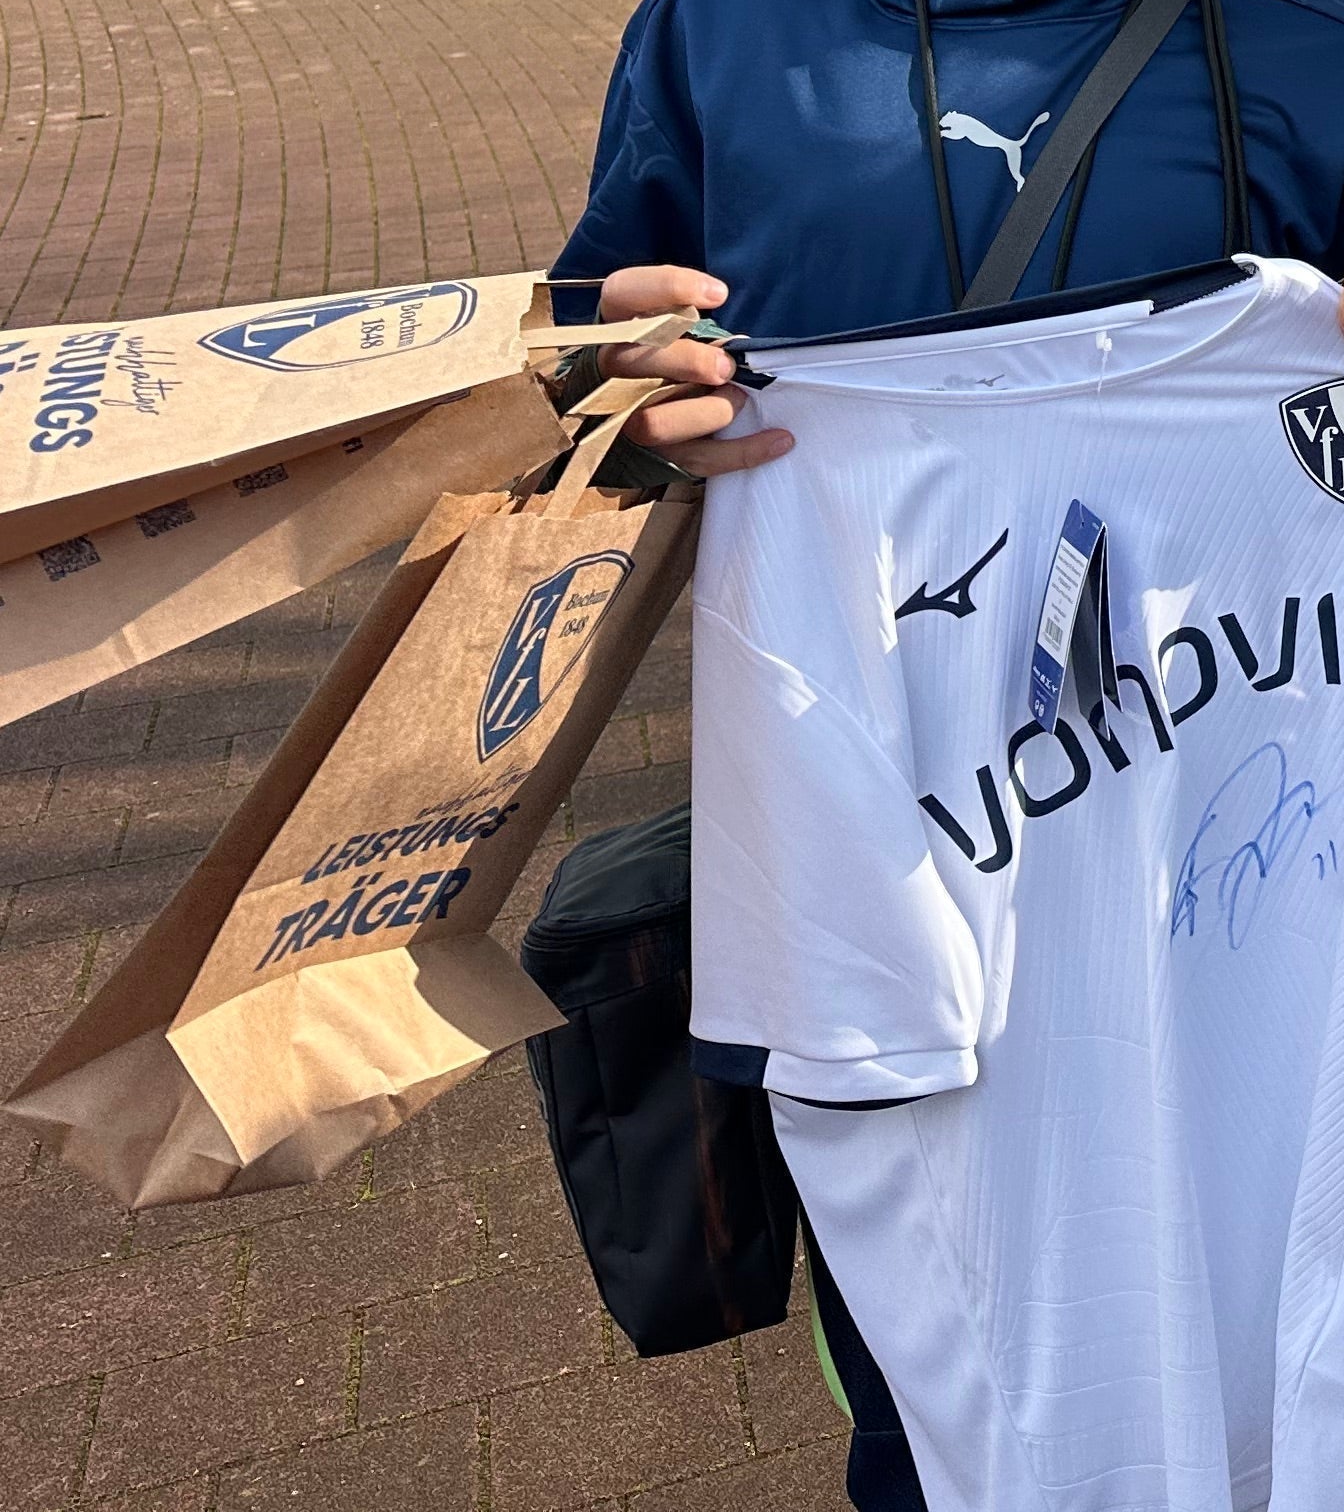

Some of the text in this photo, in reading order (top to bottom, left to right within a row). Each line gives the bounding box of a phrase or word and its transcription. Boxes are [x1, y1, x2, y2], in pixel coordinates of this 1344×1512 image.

[359, 317, 386, 350] 1848
[300, 801, 521, 885] LEISTUNGS
[253, 864, 472, 973] TRÄGER
